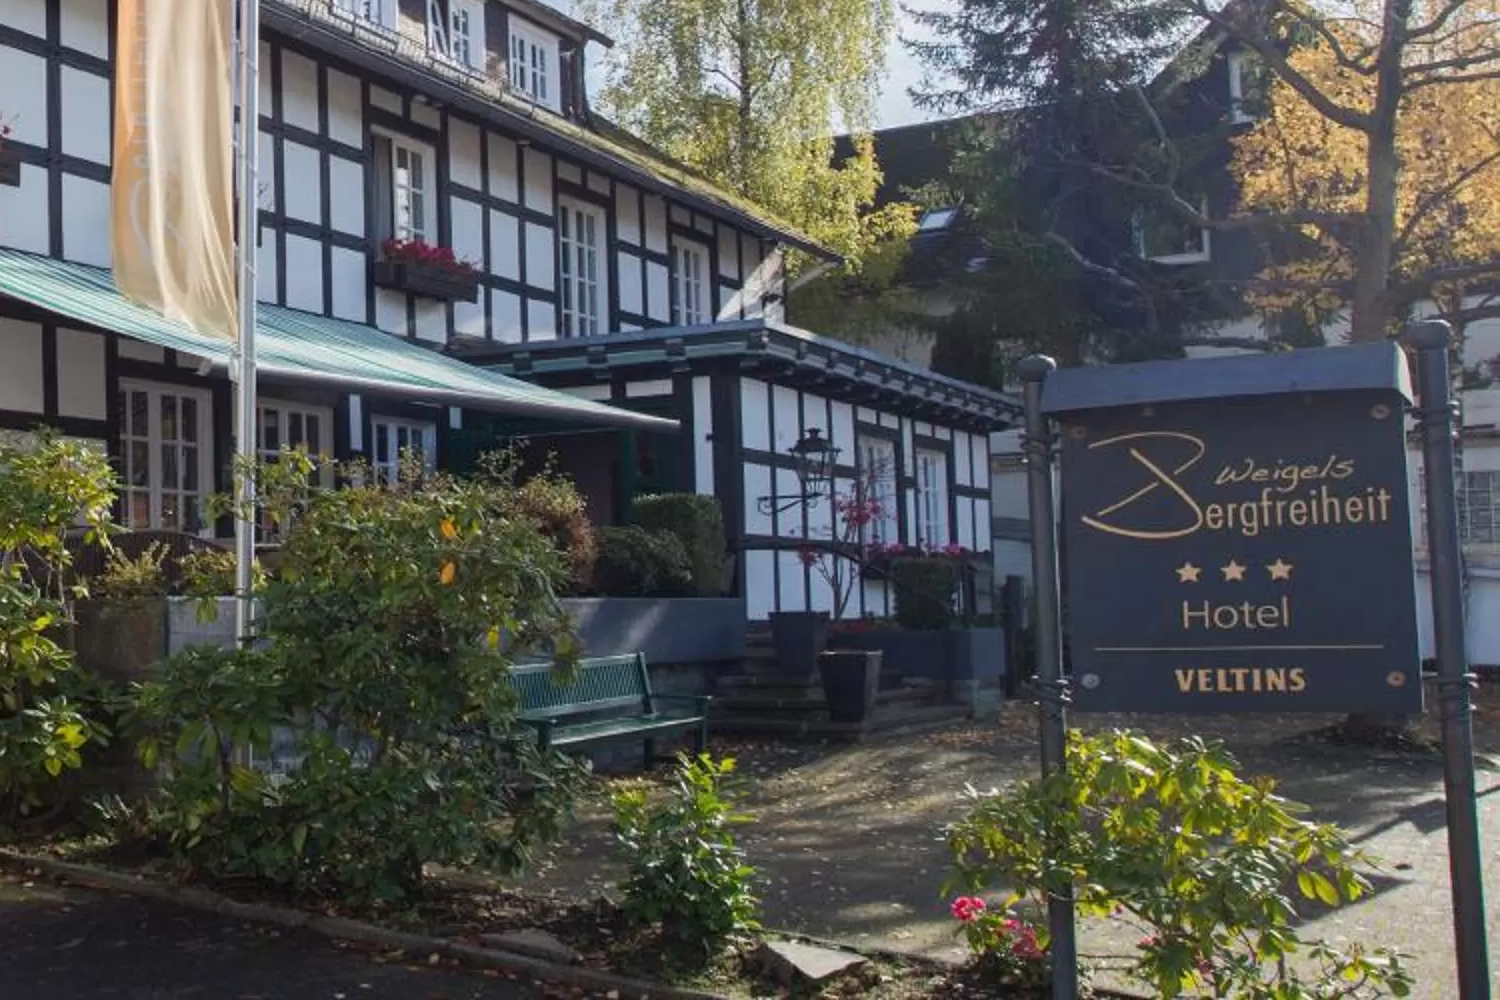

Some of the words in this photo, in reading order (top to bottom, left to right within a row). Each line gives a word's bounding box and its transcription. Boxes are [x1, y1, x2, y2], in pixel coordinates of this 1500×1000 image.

[1081, 430, 1392, 540] Bergfreiheit
[1214, 454, 1356, 493] Weigels
[1182, 596, 1291, 630] Hotel
[1174, 667, 1307, 693] VELTINS
